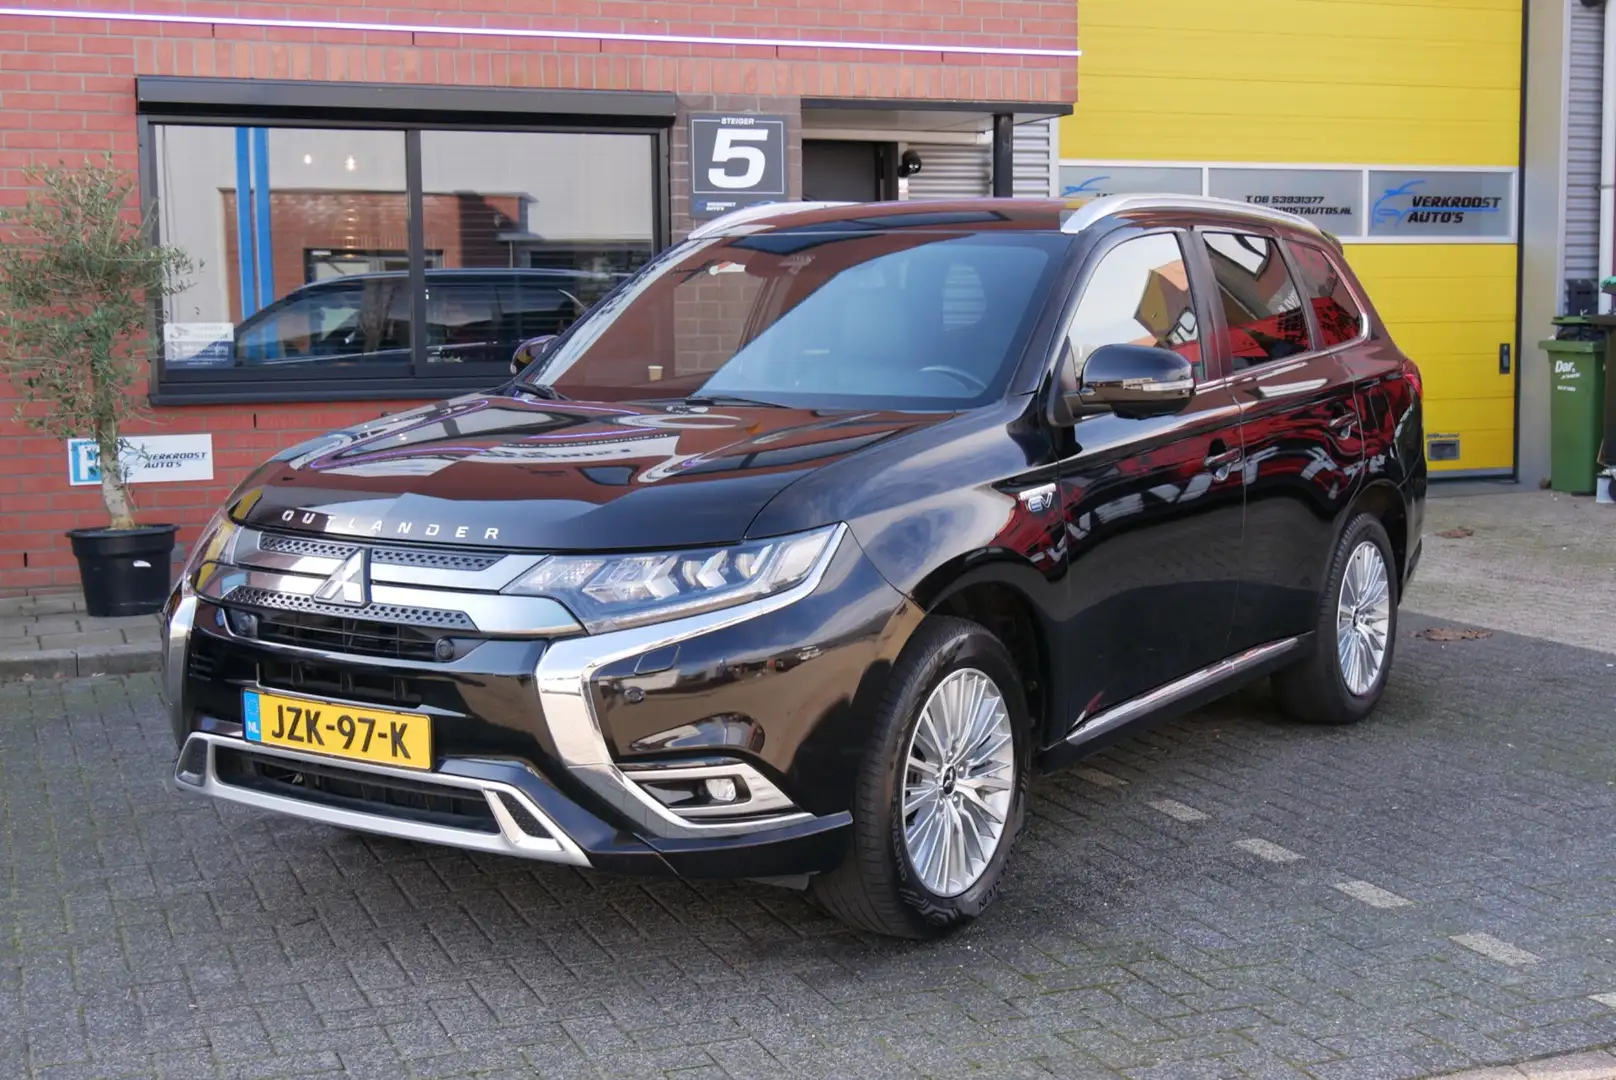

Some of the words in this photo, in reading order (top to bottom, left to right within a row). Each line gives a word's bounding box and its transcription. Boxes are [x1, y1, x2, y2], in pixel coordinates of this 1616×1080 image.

[721, 117, 755, 125] STEIGER
[708, 128, 768, 189] 5
[1412, 196, 1502, 208] VERKROOST
[1407, 211, 1464, 223] AUTO'S
[143, 460, 182, 469] AUTO'S
[281, 510, 499, 539] OUTLANDER
[247, 721, 260, 734] NL
[271, 704, 411, 760] JZK-97-K
